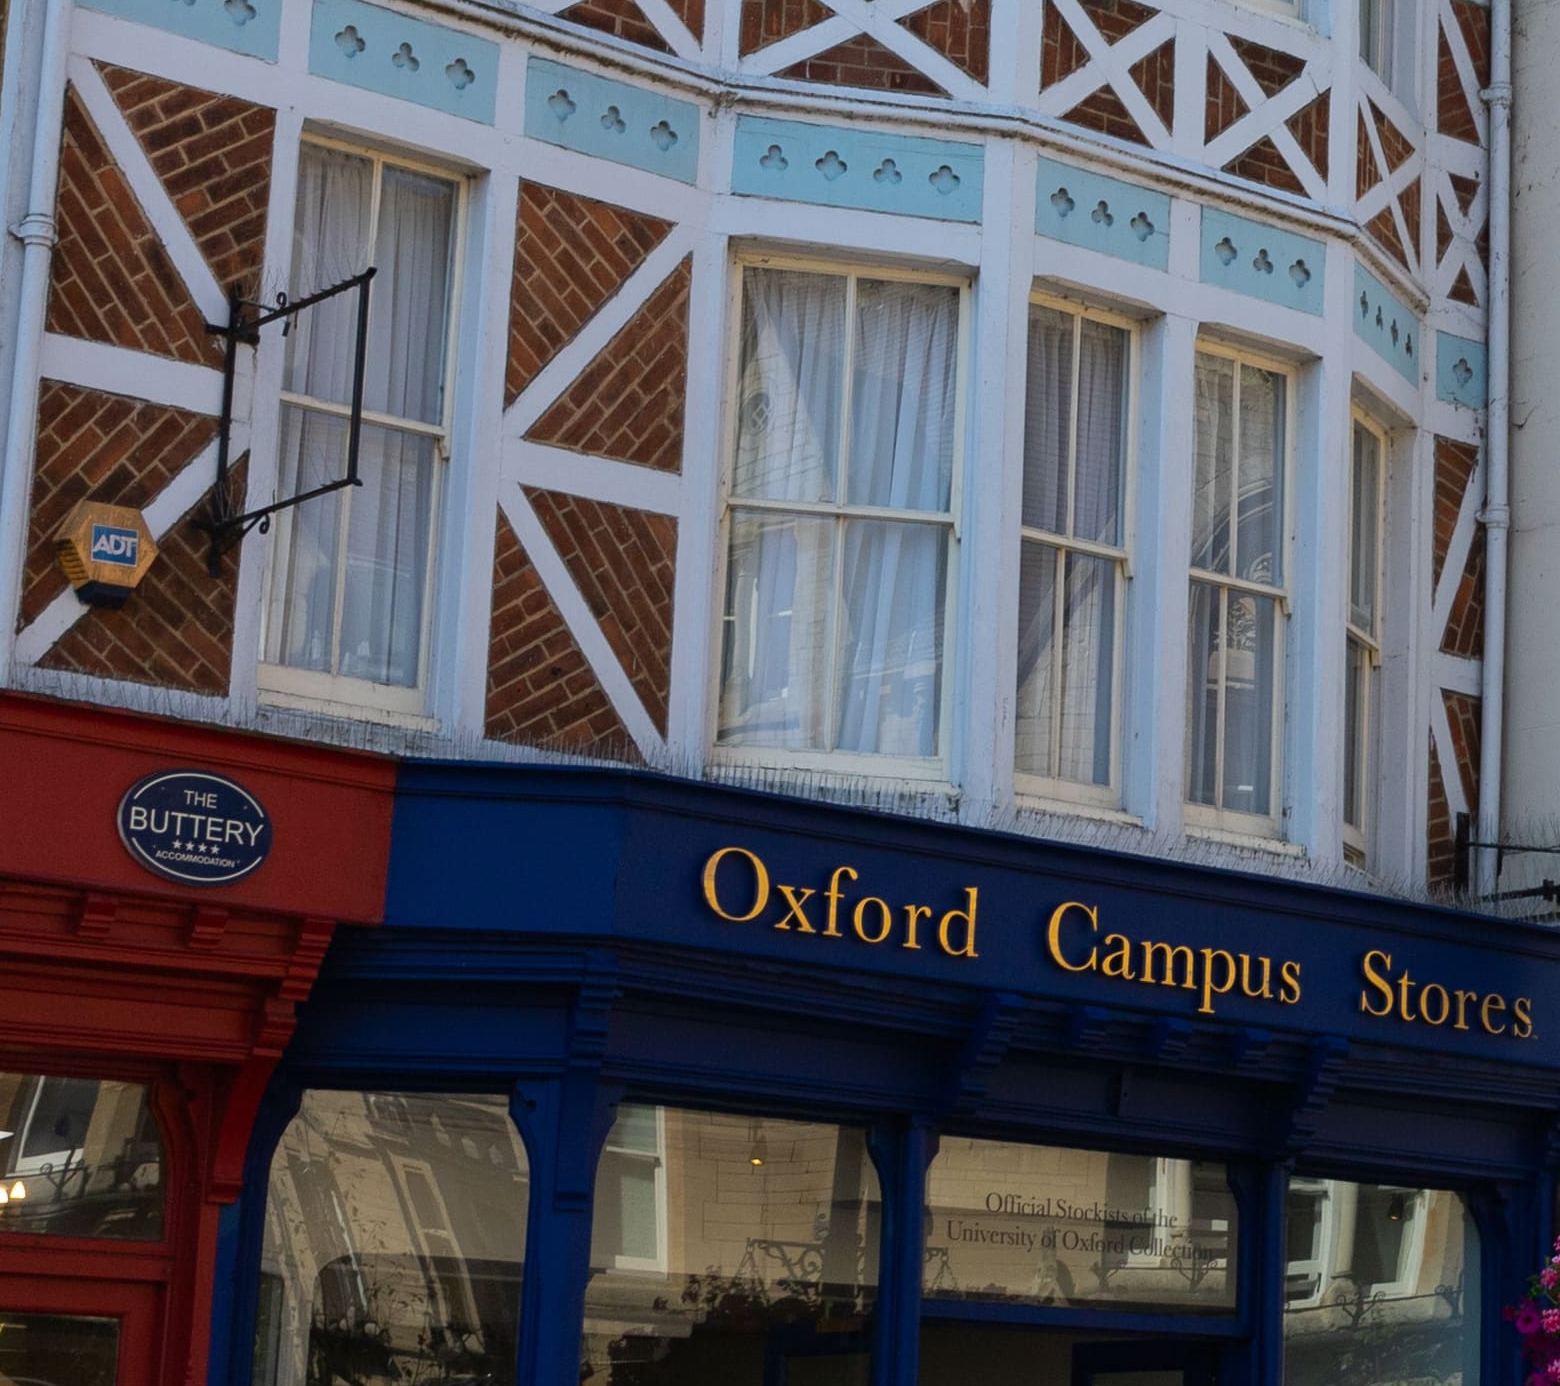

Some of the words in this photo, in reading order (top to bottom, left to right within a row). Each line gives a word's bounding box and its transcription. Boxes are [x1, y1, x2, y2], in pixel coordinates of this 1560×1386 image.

[93, 534, 137, 558] ADT
[183, 789, 218, 810] THE
[129, 806, 264, 847] BUTTERY
[155, 850, 236, 869] ACCOMMODATION
[702, 846, 980, 958] Oxford
[1046, 901, 1301, 1014] Campus
[1360, 950, 1533, 1039] Stores
[985, 1192, 1051, 1218] Official
[1056, 1198, 1128, 1223] Stockists
[1132, 1207, 1150, 1226] of
[1151, 1208, 1178, 1229] the
[947, 1220, 1036, 1252] University
[1041, 1229, 1059, 1250] of
[1062, 1229, 1124, 1255] Oxford
[1129, 1235, 1213, 1261] Collection
